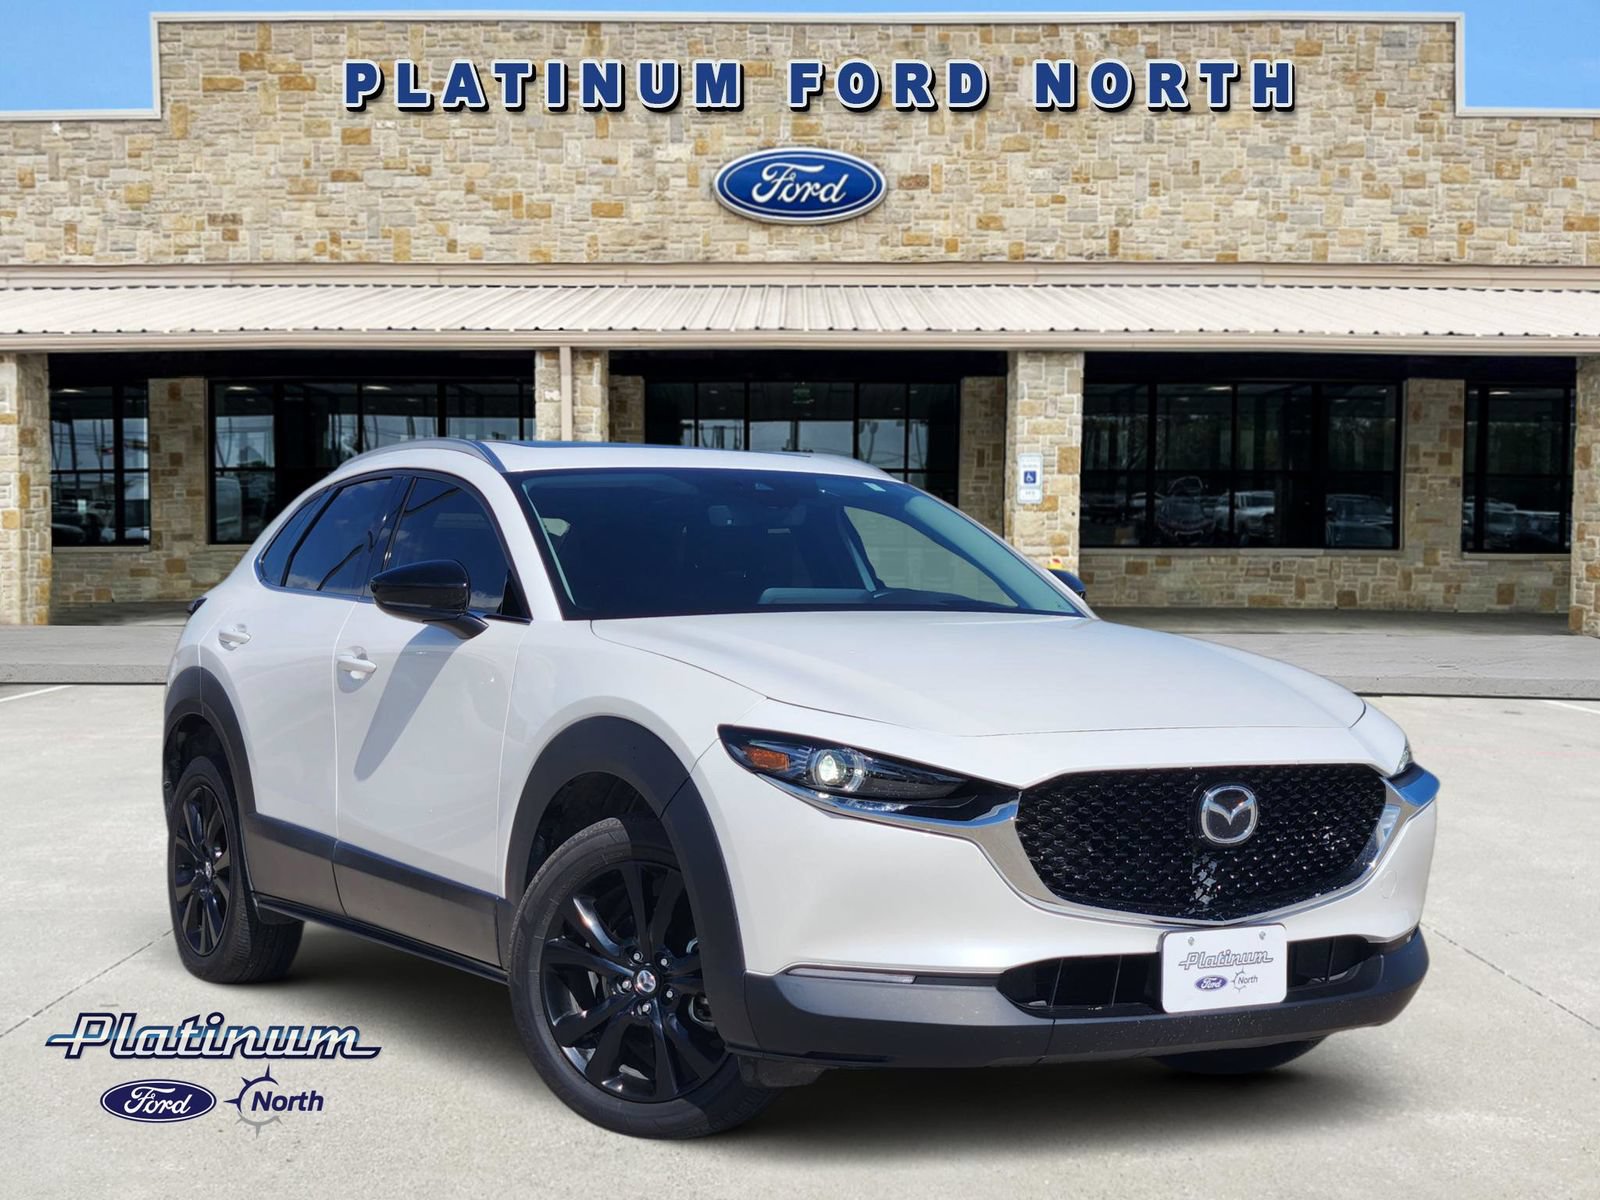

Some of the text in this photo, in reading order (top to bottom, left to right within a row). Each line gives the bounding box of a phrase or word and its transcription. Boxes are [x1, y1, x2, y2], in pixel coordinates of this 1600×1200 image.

[344, 59, 1295, 111] PLATINUM FORD NORTH
[751, 163, 849, 204] Ford
[1178, 949, 1274, 970] Platinum
[1200, 975, 1258, 989] Ford North
